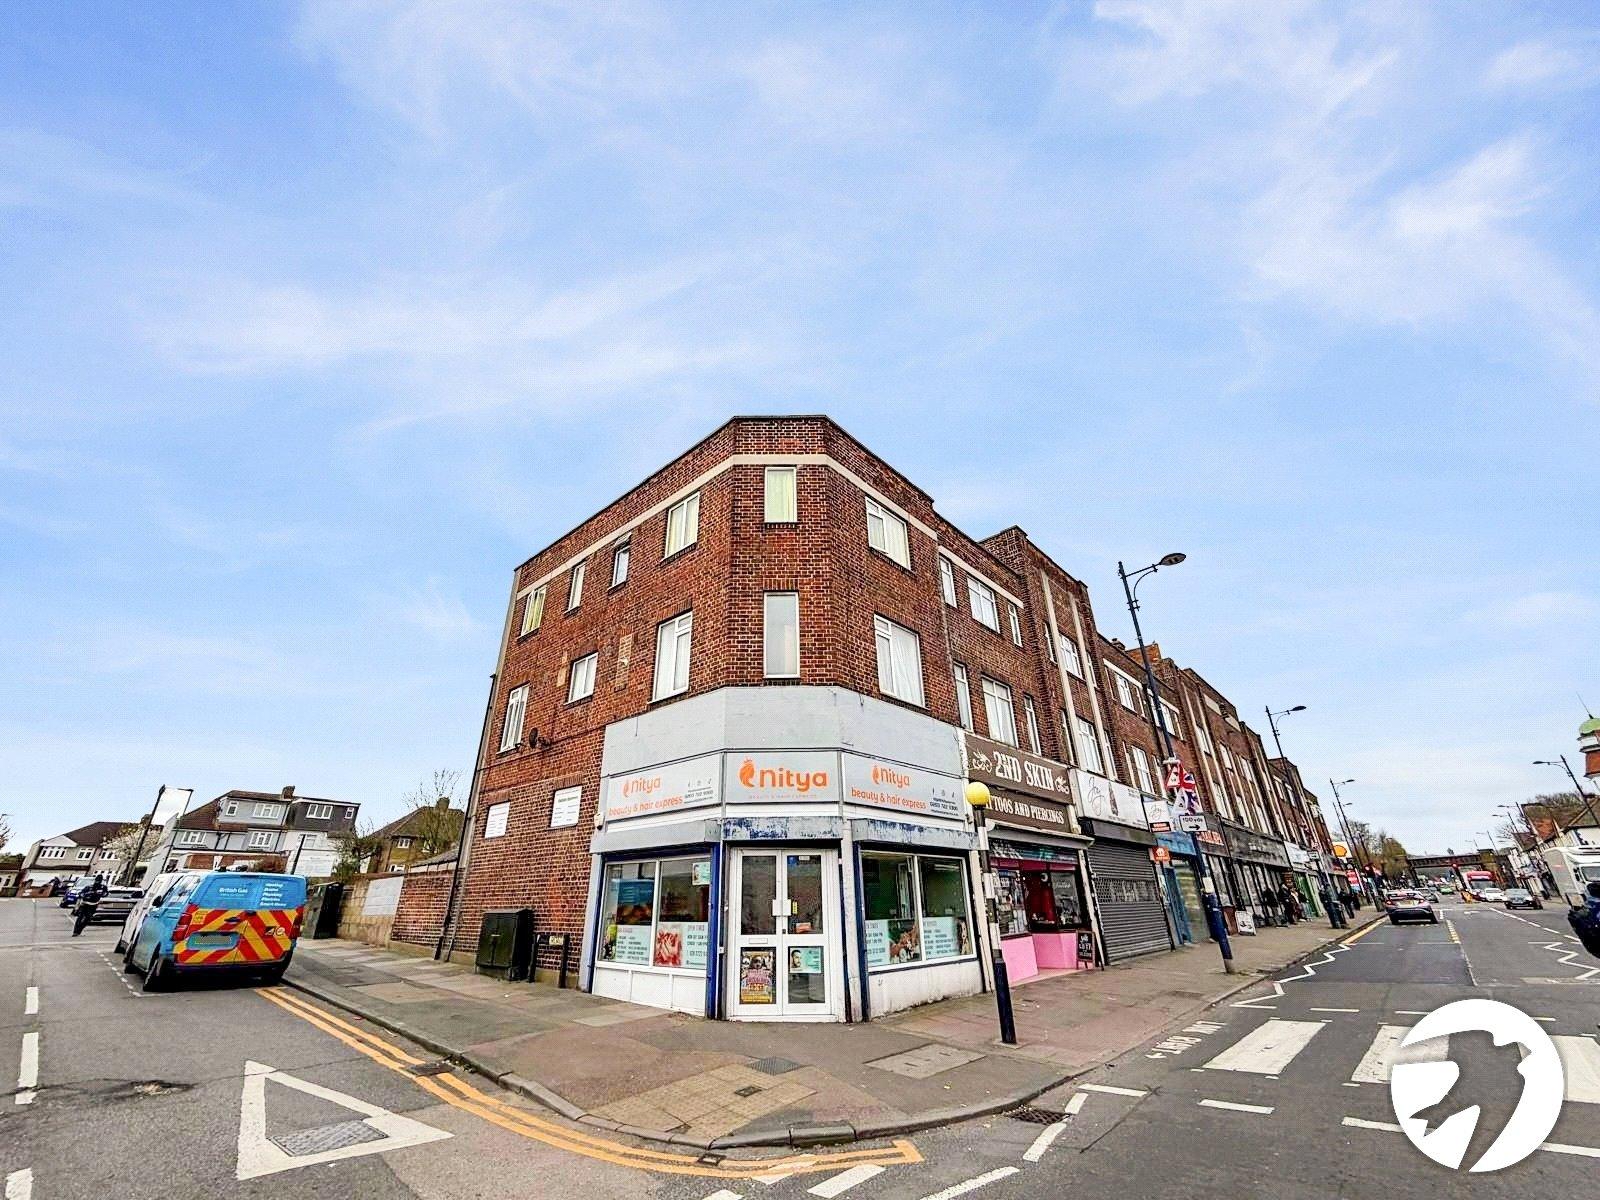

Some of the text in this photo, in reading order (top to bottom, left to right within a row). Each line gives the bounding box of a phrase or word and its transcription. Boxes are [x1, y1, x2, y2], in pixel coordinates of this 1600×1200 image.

[759, 767, 828, 792] nitya
[880, 766, 910, 788] nitya
[993, 751, 1055, 791] 2ND SKIN
[631, 777, 661, 793] nitya
[608, 806, 632, 817] beauty
[639, 801, 654, 812] hair
[655, 797, 683, 809] express
[851, 787, 879, 803] beauty
[887, 793, 901, 805] hair
[902, 798, 927, 811] express
[1014, 801, 1031, 818] AND
[1030, 805, 1065, 825] PIERCINGS
